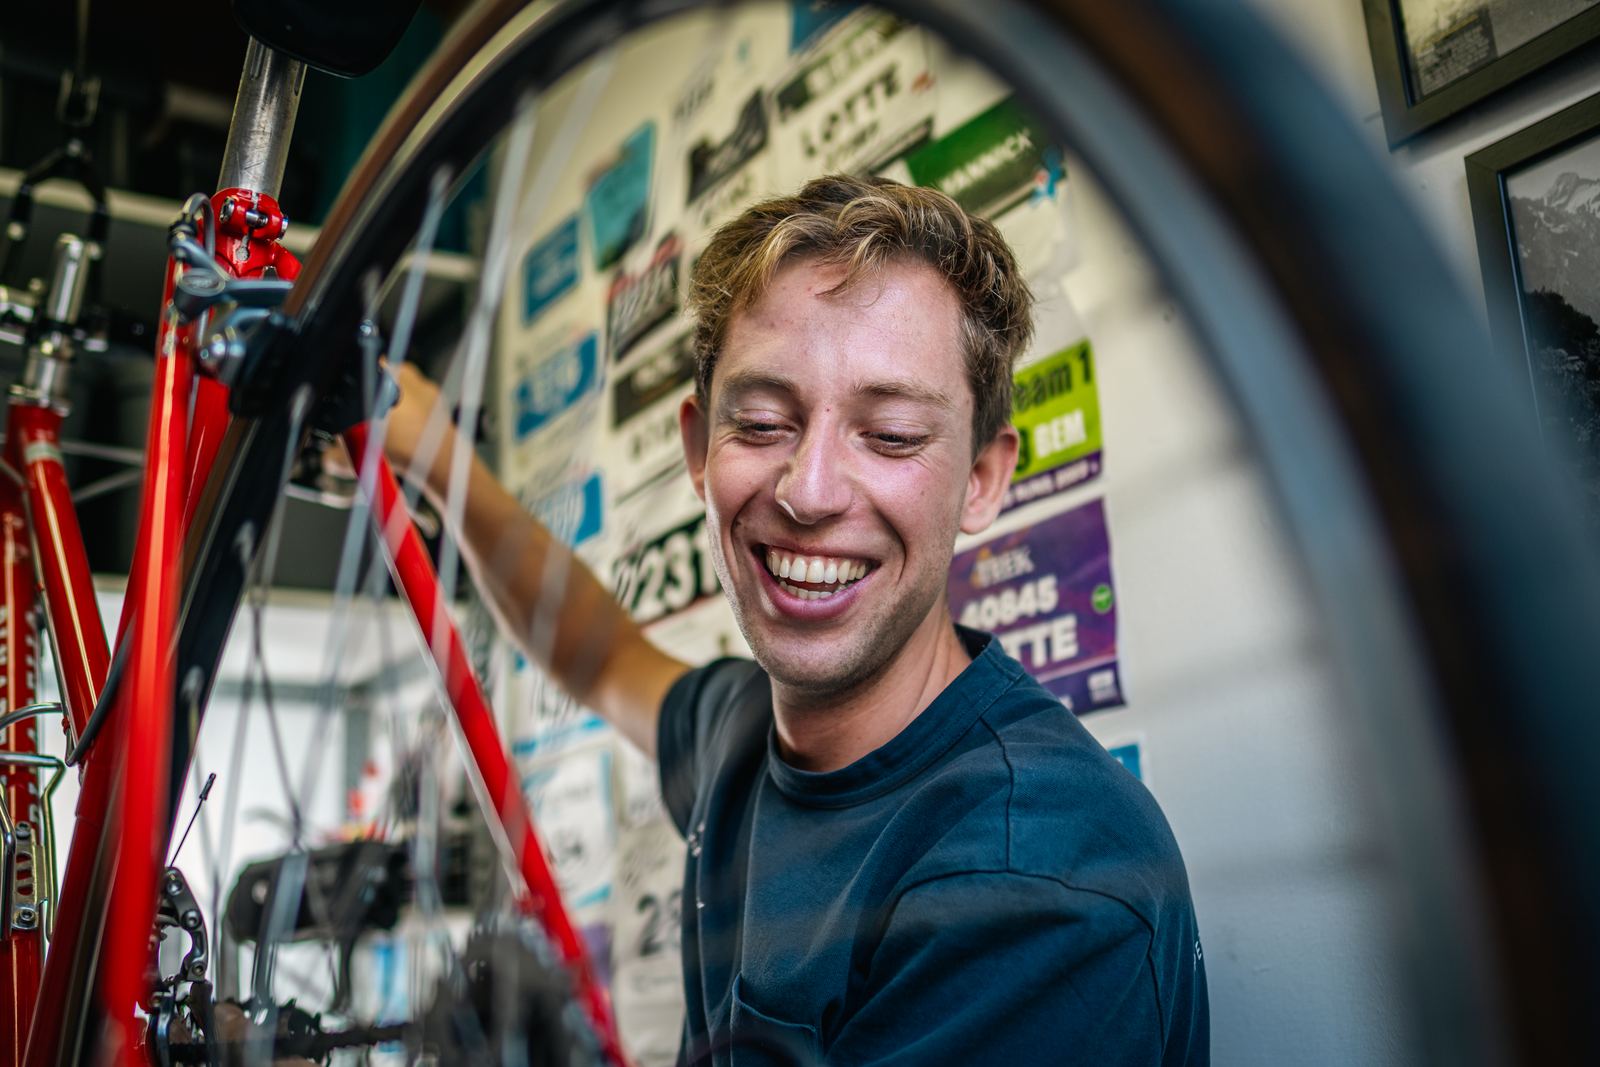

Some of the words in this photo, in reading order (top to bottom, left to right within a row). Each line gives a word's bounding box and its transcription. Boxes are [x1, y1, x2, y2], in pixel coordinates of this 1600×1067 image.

[802, 62, 899, 157] LOTTE
[1014, 362, 1073, 413] eam
[1078, 344, 1092, 384] 1
[958, 574, 1060, 630] 40845
[1001, 613, 1079, 668] TTE
